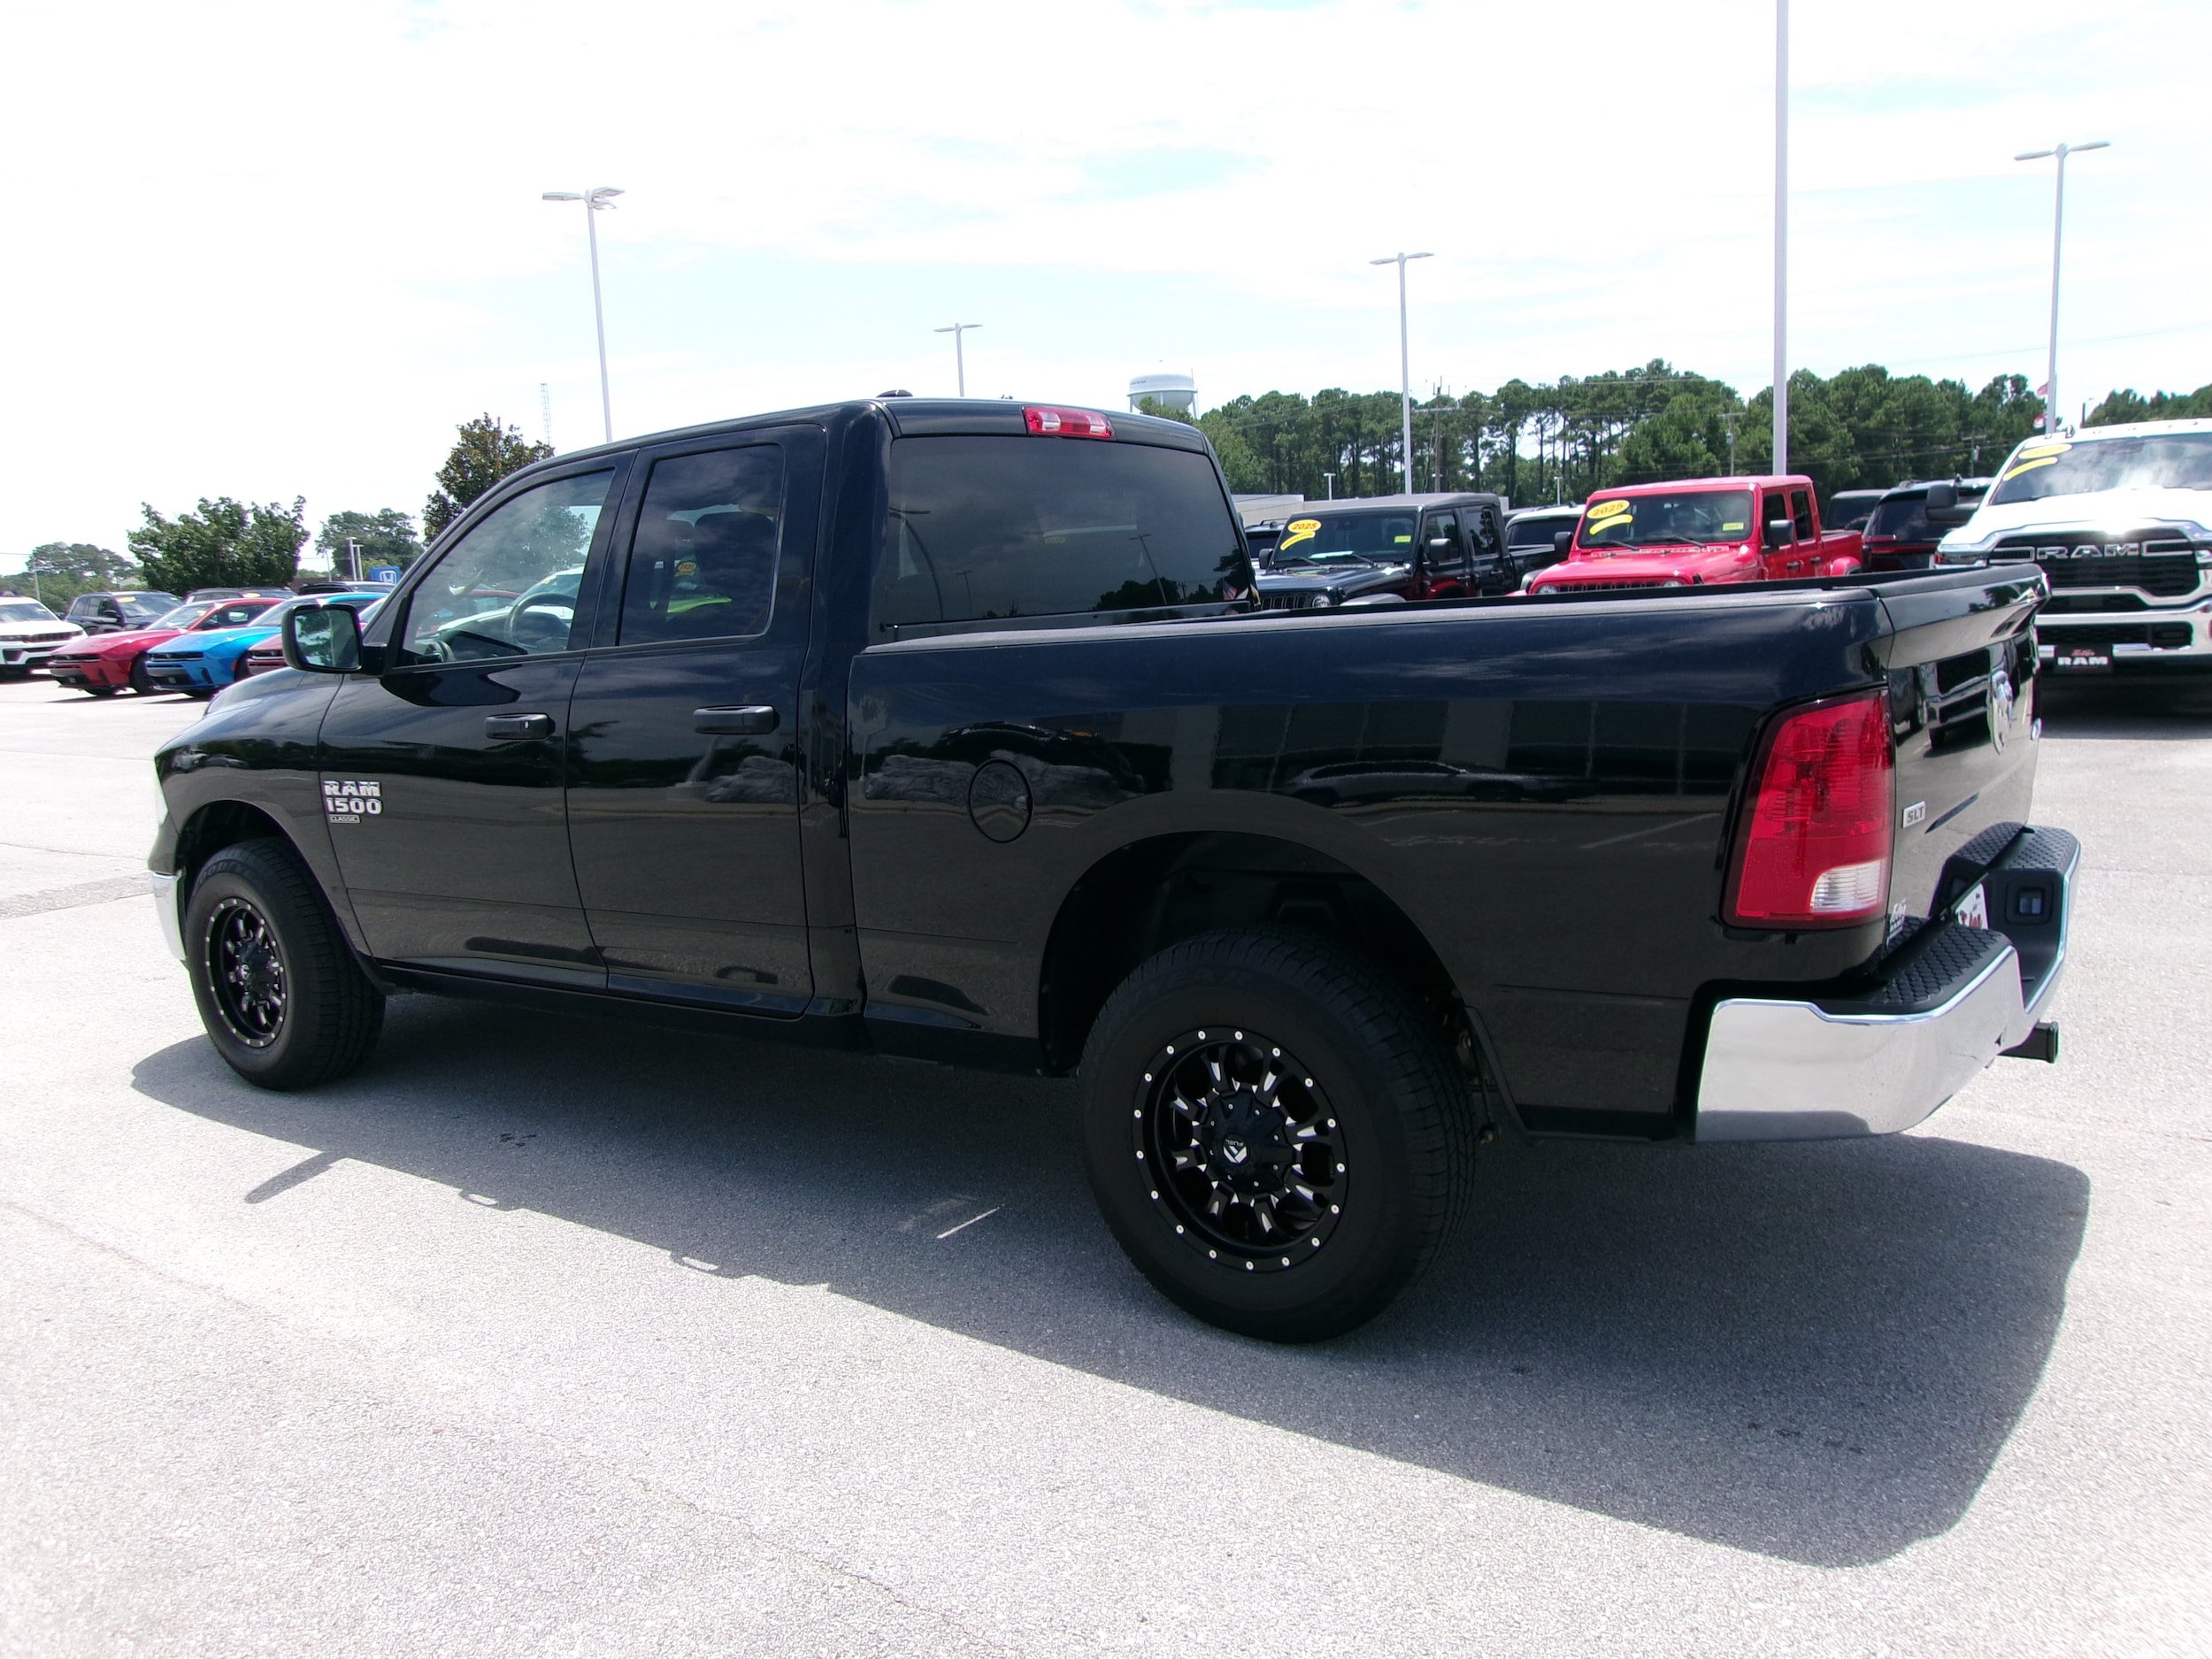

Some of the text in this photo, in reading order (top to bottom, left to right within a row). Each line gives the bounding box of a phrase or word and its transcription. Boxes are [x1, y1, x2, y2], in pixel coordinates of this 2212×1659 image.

[2036, 542, 2139, 560] RAM
[2057, 657, 2108, 665] RAM
[324, 780, 381, 797] RAM
[326, 797, 383, 815] 1500
[1907, 805, 1925, 823] SLT
